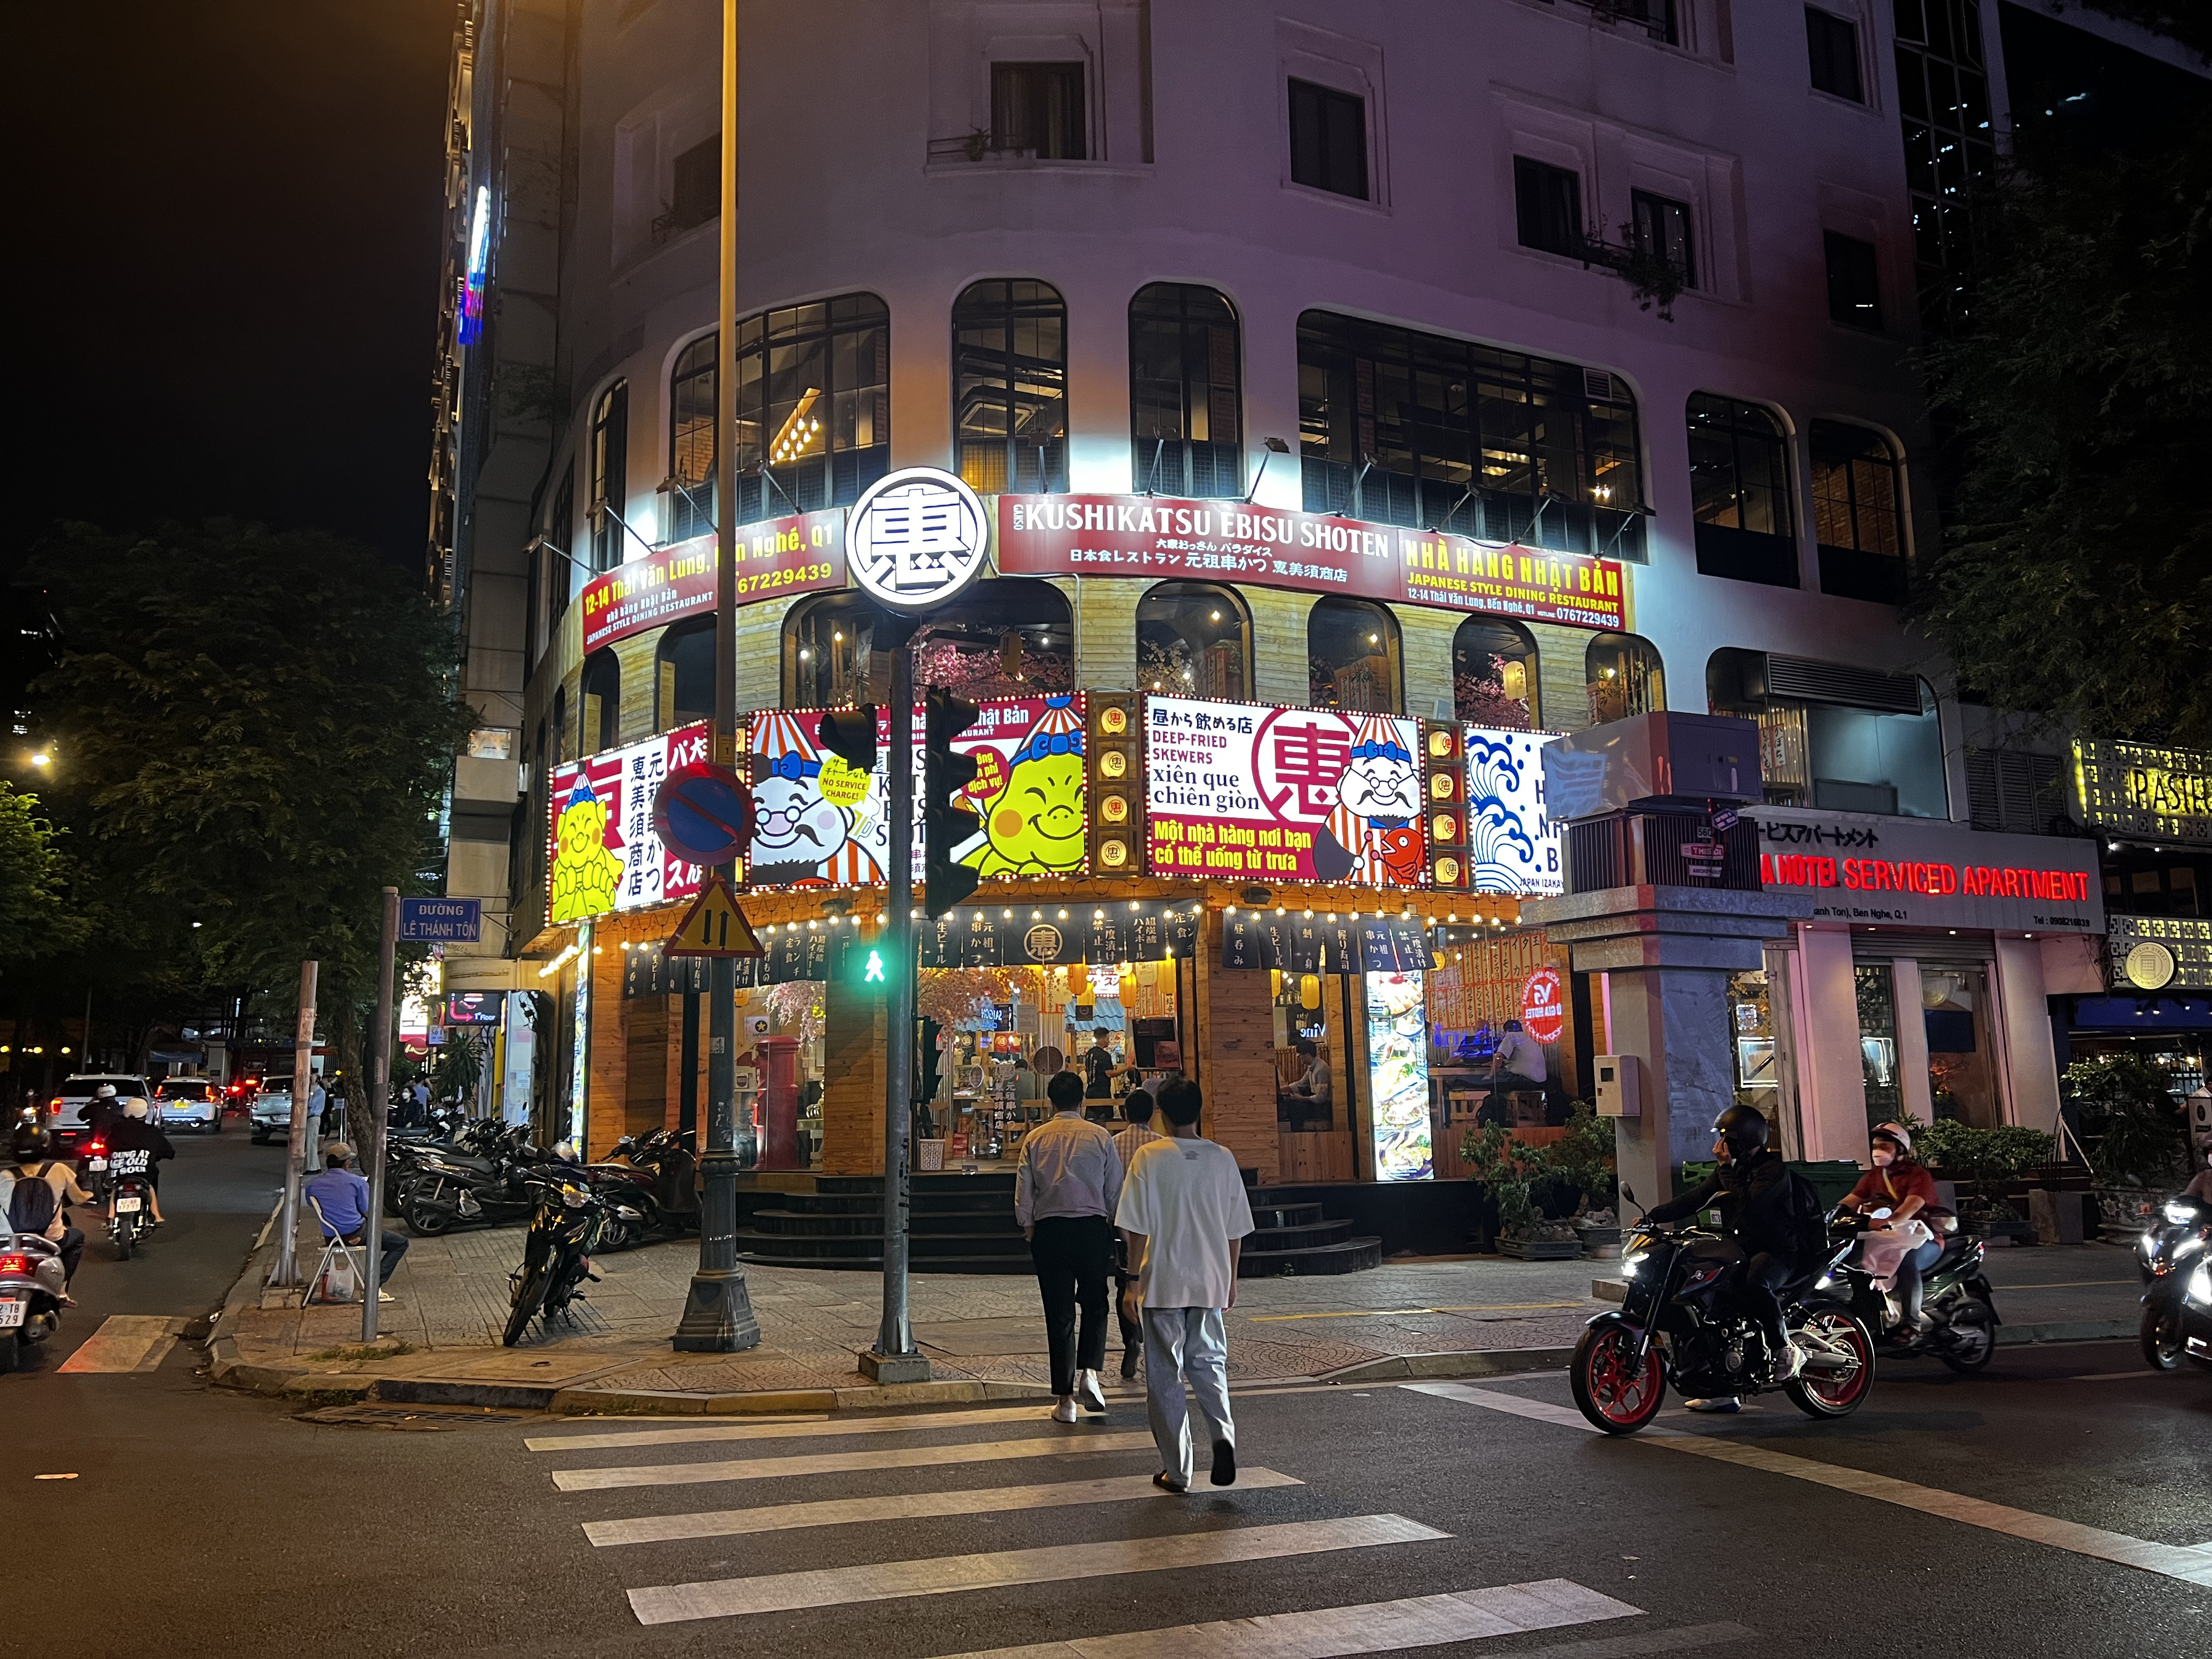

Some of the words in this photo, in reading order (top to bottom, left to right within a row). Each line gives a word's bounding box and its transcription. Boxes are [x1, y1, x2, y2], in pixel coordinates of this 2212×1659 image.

[1013, 504, 1024, 531] GANSO
[1026, 503, 1211, 536] KUSHIKATSU
[1220, 511, 1294, 545] EBISU
[1300, 521, 1389, 559] SHOTEN
[1070, 549, 1181, 565] 日本食レストラン
[1184, 552, 1267, 572] 元祖串かつ
[1220, 542, 1273, 557] パラダイス
[585, 585, 609, 616] 12-14
[612, 573, 637, 602] Thái
[639, 564, 665, 591] Văn
[669, 553, 711, 581] Lung,
[752, 526, 806, 559] Nghé,
[811, 523, 833, 547] Q1
[737, 562, 832, 593] 67229439
[1405, 538, 1450, 572] NHÀ
[1456, 544, 1514, 581] HÀNG
[1520, 556, 1573, 592] NHẬT
[1578, 560, 1619, 597] BẢN
[606, 607, 619, 624] nhà
[620, 602, 638, 617] hàng
[640, 593, 659, 610] Nhật
[661, 587, 677, 603] Bản
[1407, 572, 1468, 592] JAPANESE
[1470, 581, 1503, 596] STYLE
[1505, 586, 1546, 602] DINING
[1549, 592, 1619, 613] RESTAURANT
[587, 624, 612, 645] JAPANESE
[612, 617, 630, 632] STYLE
[632, 608, 658, 624] DINING
[660, 591, 713, 615] RESTAURANT
[1407, 587, 1428, 601] 12-14
[1430, 590, 1447, 603] Thái
[1448, 592, 1463, 605] Văn
[1487, 597, 1502, 611] Bến
[1557, 607, 1619, 628] 0767229439
[972, 708, 1000, 729] hật
[1003, 705, 1029, 724] Bản
[1152, 708, 1253, 734] 昼から飲める店
[958, 728, 994, 738] AURANT
[1152, 730, 1227, 748] DEEP-FRIED
[976, 753, 994, 765] ông
[984, 761, 999, 777] phí
[1152, 748, 1212, 764] SKEWERS
[822, 778, 834, 786] NO
[836, 780, 867, 790] SERVICE
[968, 778, 988, 793] dịch
[989, 775, 1003, 788] vụ!
[1153, 764, 1197, 784] xiên
[1203, 771, 1239, 791] que
[826, 789, 859, 800] CHARGE!
[1154, 786, 1211, 807] chiên
[1216, 789, 1260, 813] giòn
[1154, 819, 1184, 844] Một
[1187, 822, 1215, 843] nhà
[1218, 823, 1255, 847] hàng
[1259, 827, 1281, 847] nơi
[1284, 830, 1311, 853] bạn
[1759, 821, 1879, 848] ービスアパートメント
[1154, 843, 1173, 864] có
[1177, 842, 1203, 866] thể
[1206, 846, 1243, 870] uống
[1246, 848, 1263, 870] từ
[1266, 851, 1297, 871] trưa
[1519, 878, 1540, 888] JAPAN
[1775, 854, 1840, 888] HOTEL
[1843, 857, 1957, 895] SERVICED
[1964, 865, 2089, 901] APARTMENT
[418, 903, 464, 916] ĐƯỜNG
[1831, 907, 1851, 918] Ton),
[1853, 908, 1869, 917] Ben
[1870, 909, 1893, 920] Nghe,
[1895, 910, 1907, 920] Q.1
[403, 920, 416, 936] LÊ
[419, 919, 453, 936] THÁNH
[456, 921, 477, 937] TÔN
[983, 922, 994, 948] 元祖
[1134, 918, 1146, 959] ハイボール
[1145, 916, 1157, 944] 超炭酸
[1174, 912, 1187, 939] 定食
[785, 937, 794, 963] 定食
[936, 922, 948, 964] 生ビール
[971, 922, 982, 963] 串かつ
[1105, 919, 1116, 962] 二度漬け
[1234, 923, 1244, 966] 昼呑み
[1270, 926, 1283, 967] 生ビール
[1302, 928, 1313, 969] 刺身
[1337, 929, 1349, 971] 握り寿司
[1365, 930, 1382, 968] 串かつ
[1376, 931, 1389, 954] 元祖
[806, 935, 817, 977] ハイボール
[1502, 940, 1510, 978] サーモン
[1512, 938, 1521, 977] イカ
[1522, 937, 1531, 975] タコ
[650, 954, 659, 992] 生ビール
[111, 1150, 137, 1159] OUNG
[126, 1157, 148, 1167] OLD
